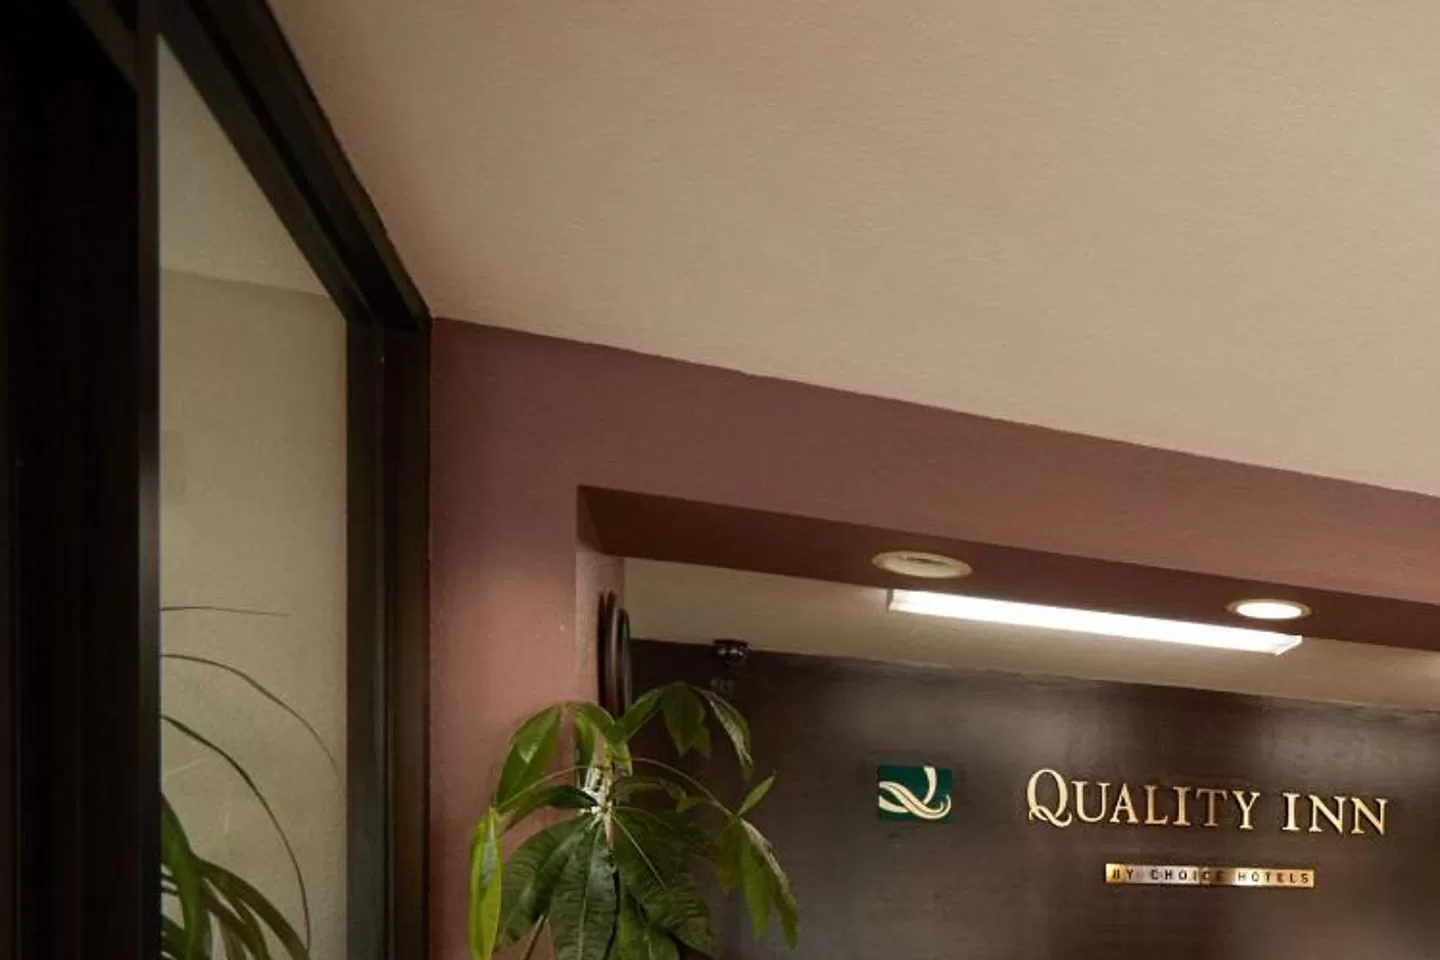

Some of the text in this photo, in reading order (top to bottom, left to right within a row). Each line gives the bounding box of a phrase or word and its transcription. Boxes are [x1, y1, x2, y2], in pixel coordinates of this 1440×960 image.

[1026, 769, 1388, 836] QUALITY INN
[1150, 868, 1226, 882] CHOICE
[1237, 872, 1309, 885] HOTELS
